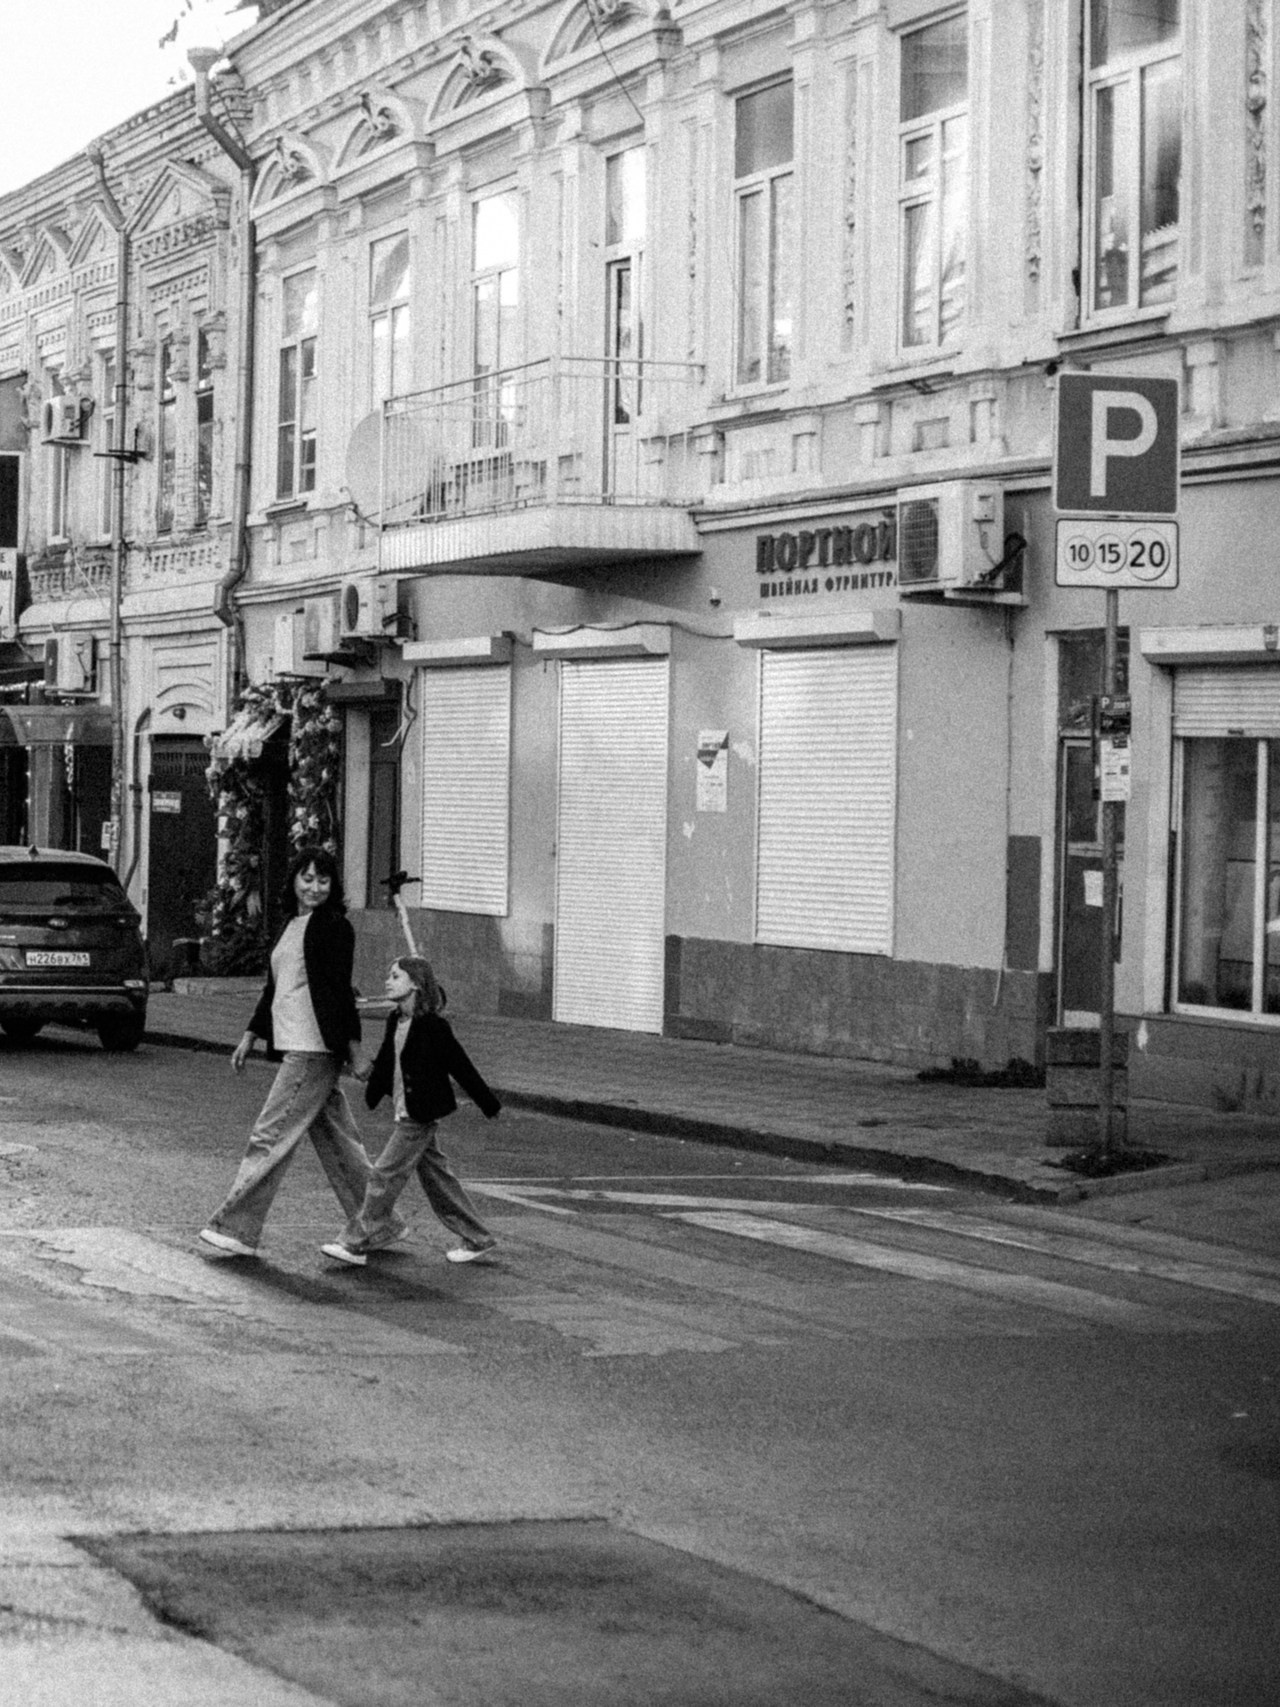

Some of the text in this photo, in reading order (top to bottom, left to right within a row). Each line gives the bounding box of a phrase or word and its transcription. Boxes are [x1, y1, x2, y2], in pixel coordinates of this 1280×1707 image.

[1090, 389, 1158, 497] P
[756, 510, 897, 574] ПОРТНОЙ
[1070, 540, 1165, 568] 10 15 20
[760, 577, 818, 598] ШВЕЙНАЯ
